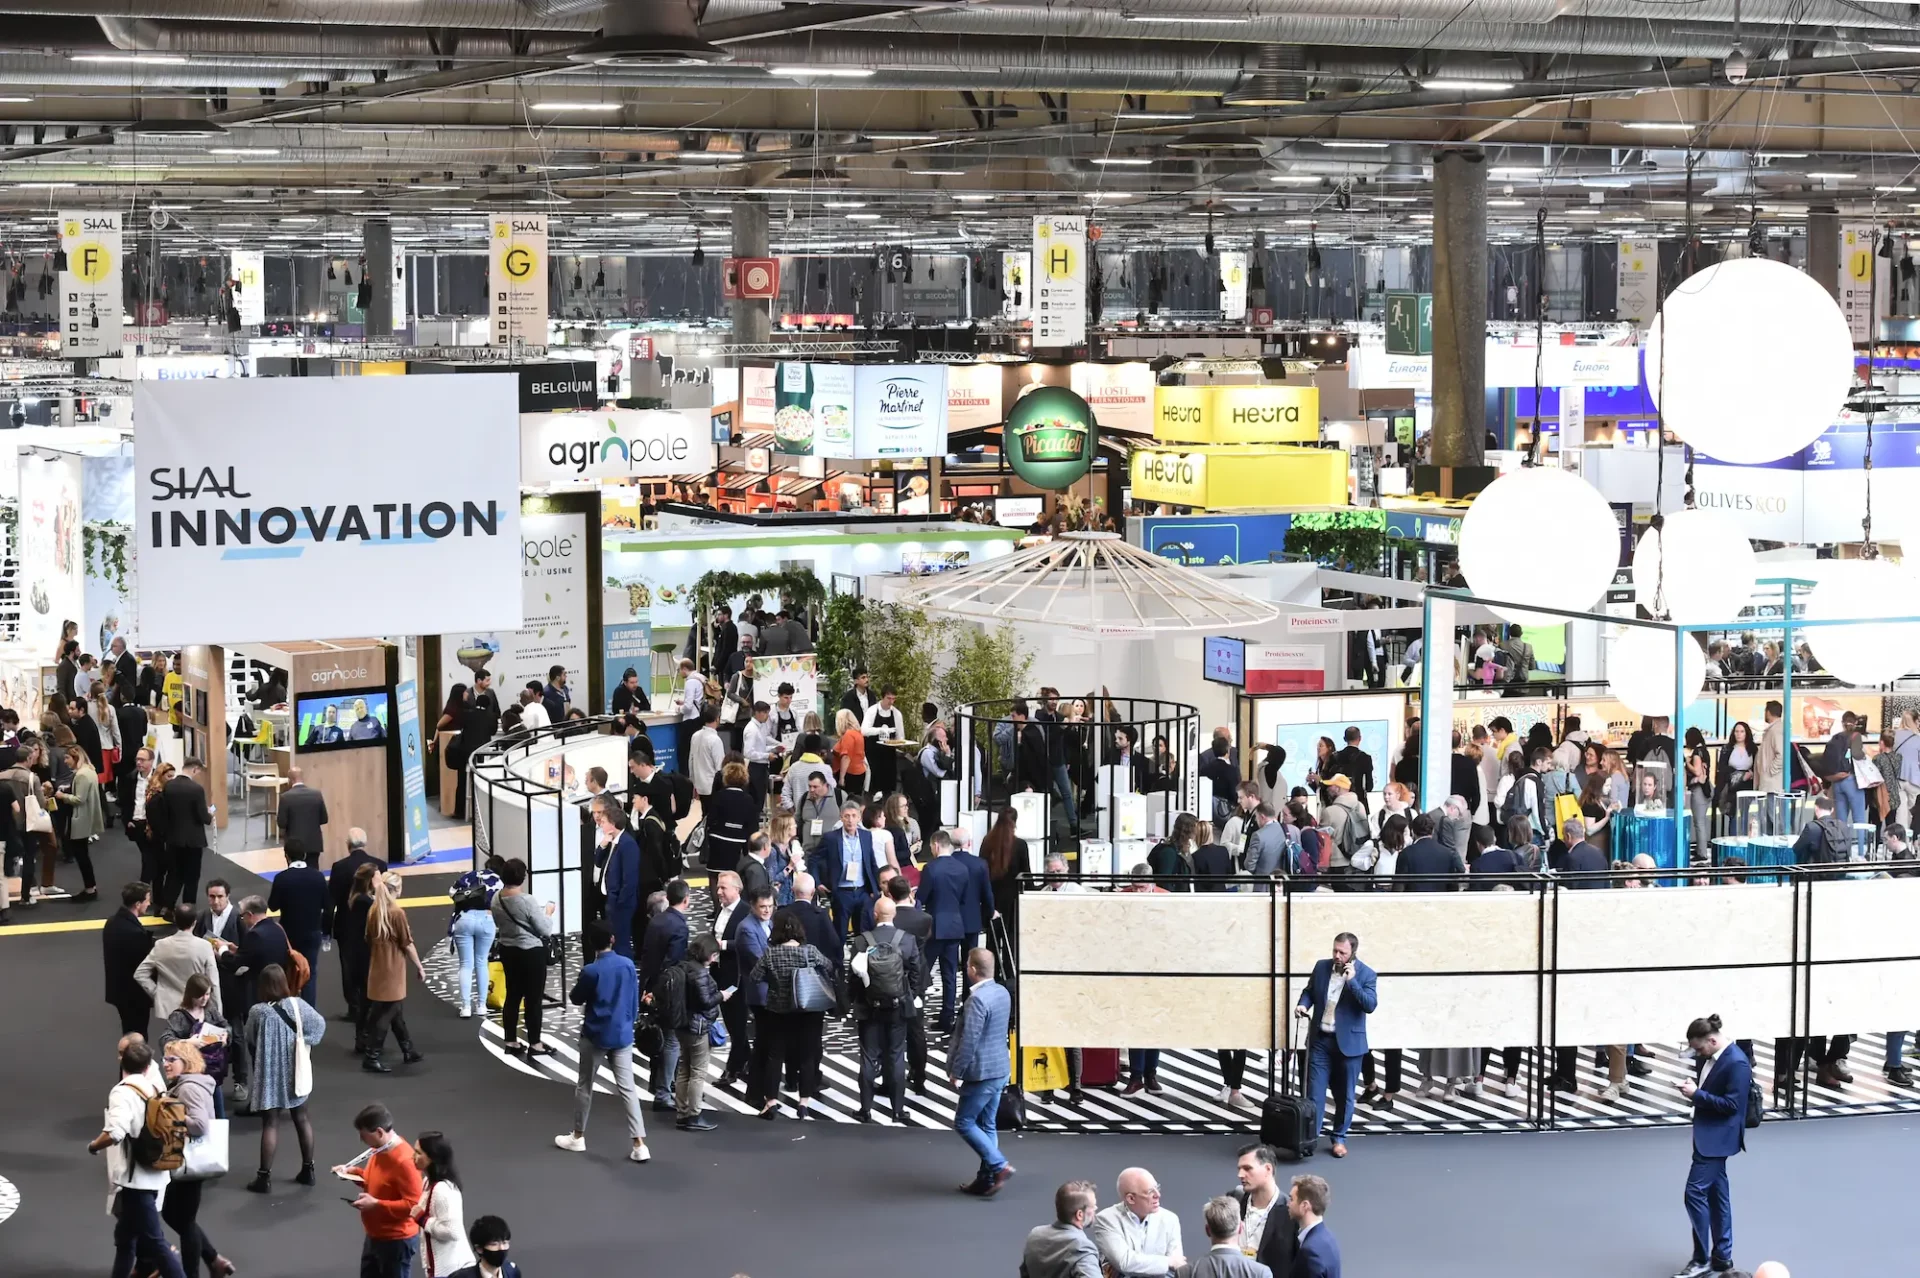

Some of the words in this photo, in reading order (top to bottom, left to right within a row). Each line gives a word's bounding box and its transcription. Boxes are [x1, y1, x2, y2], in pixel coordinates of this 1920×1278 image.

[68, 228, 75, 236] 6
[83, 218, 118, 230] SIAL
[512, 220, 543, 232] SIAL
[1054, 221, 1082, 232] SIAL
[498, 229, 505, 238] 6
[84, 249, 98, 276] F
[506, 249, 531, 277] G
[892, 253, 903, 269] 6
[1051, 249, 1067, 273] H
[1857, 254, 1866, 277] J
[531, 381, 593, 395] BELGIUM
[886, 383, 919, 399] Pierre
[878, 398, 924, 414] Martinet
[1023, 432, 1083, 456] Picadeli
[150, 466, 252, 501] SIAL
[151, 500, 498, 548] INNOVATION
[524, 535, 573, 566] pole
[523, 614, 551, 622] OMPAGNER
[612, 631, 620, 640] LA
[620, 629, 645, 639] CAPSULE
